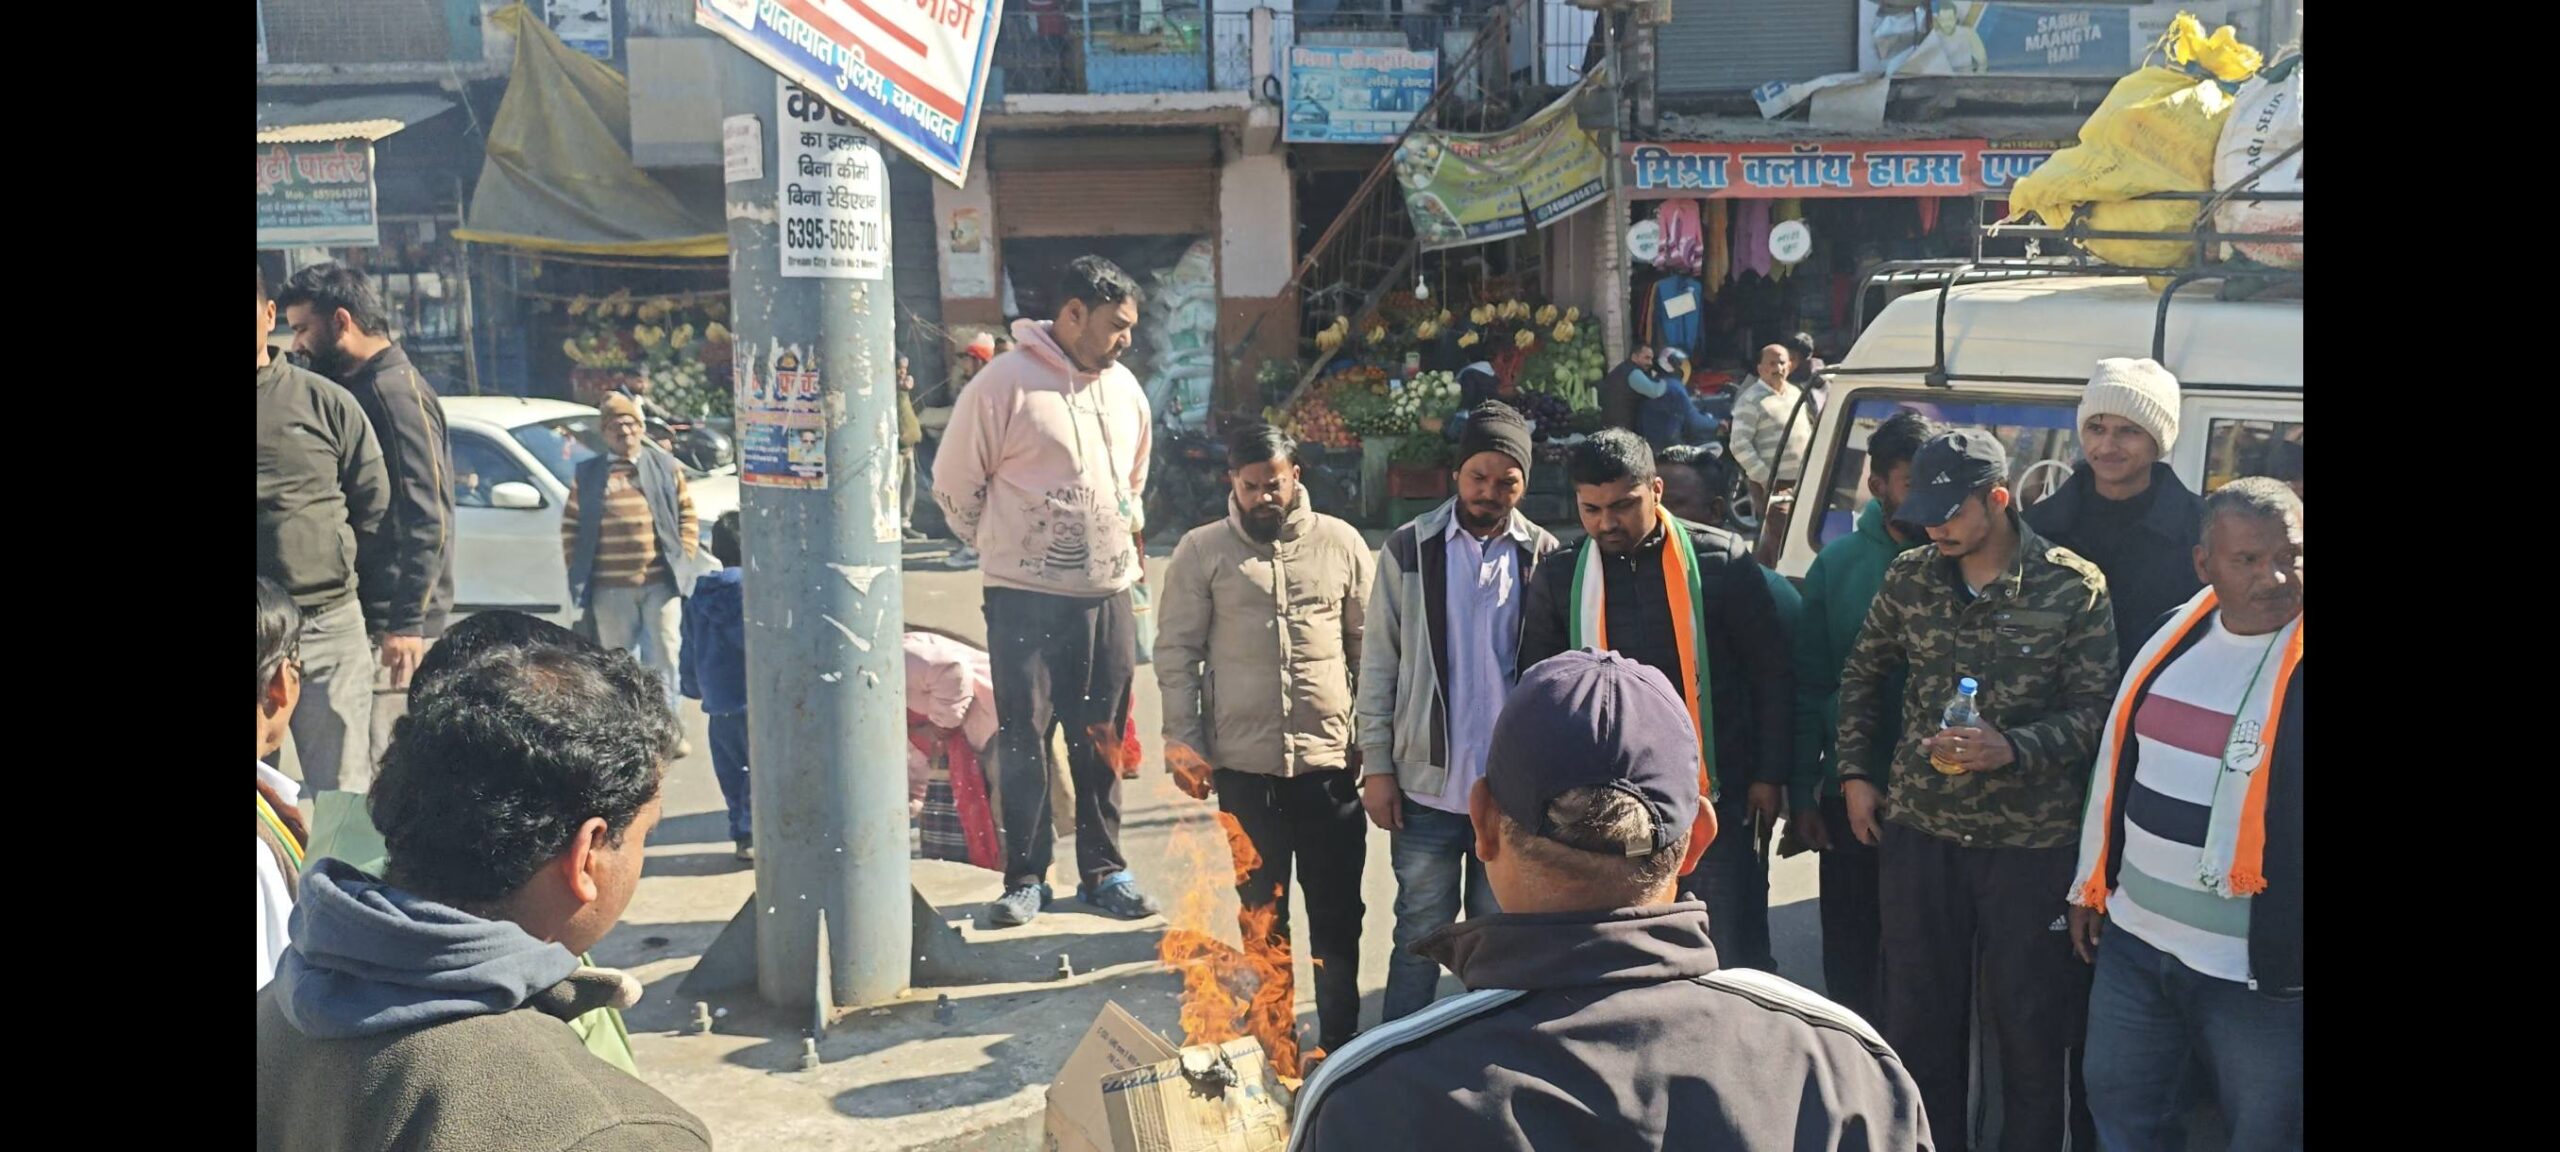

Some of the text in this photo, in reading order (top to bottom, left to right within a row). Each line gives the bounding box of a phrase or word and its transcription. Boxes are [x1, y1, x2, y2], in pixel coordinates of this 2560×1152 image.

[2025, 26, 2102, 51] MAANGTA
[2047, 45, 2080, 64] HAI!
[758, 2, 833, 66] यातायात
[835, 44, 888, 105] पुलिस,
[892, 85, 959, 145] चम्पावत
[800, 131, 867, 151] का इलाज
[798, 154, 870, 180] बिना कीमो
[1632, 145, 1730, 188] मिश्रा
[1865, 151, 1964, 186] हाउस
[787, 183, 877, 209] बिना रेडिएशन
[787, 217, 879, 251] 6395-566-700
